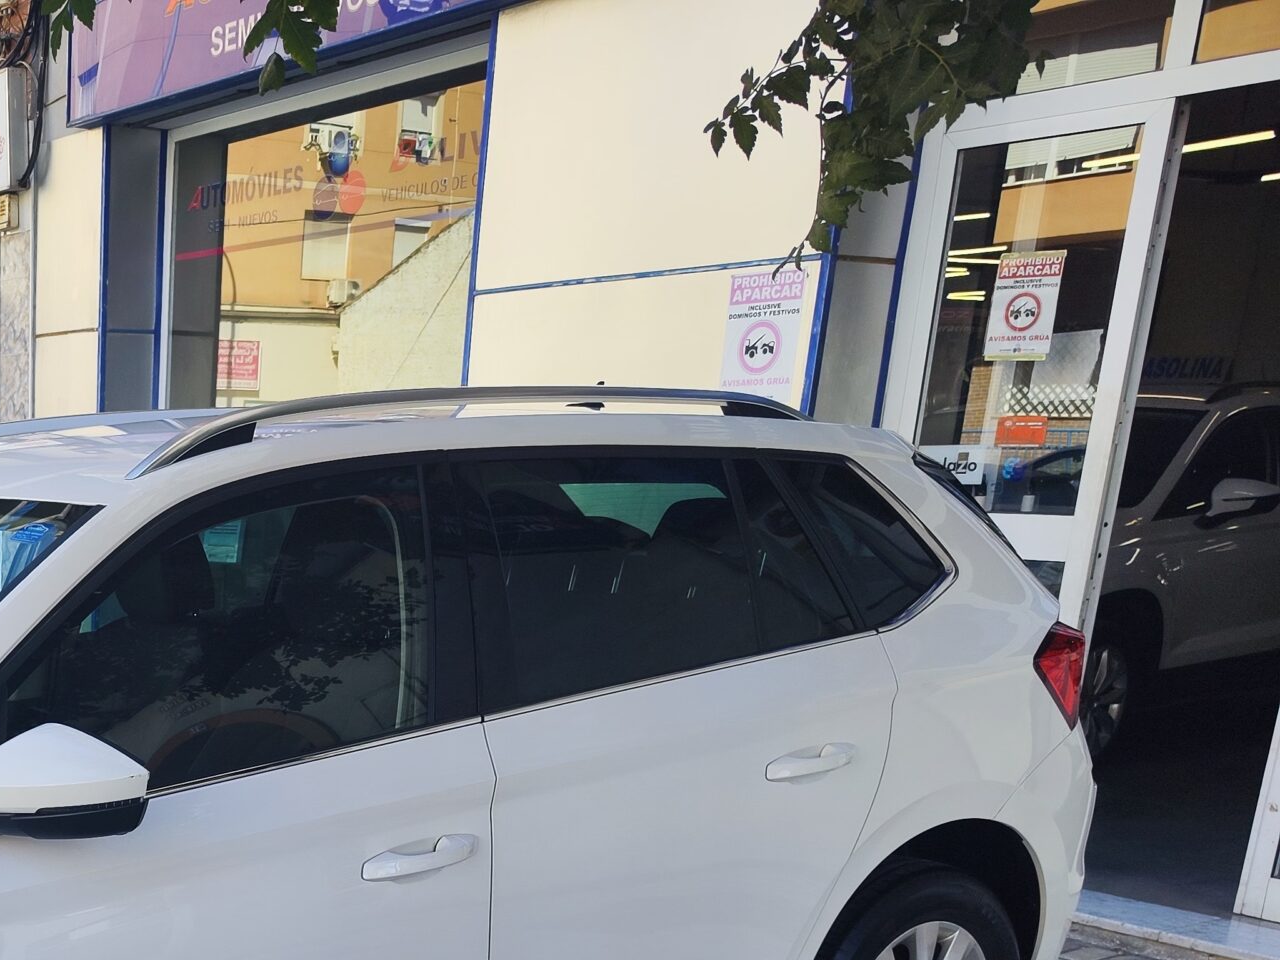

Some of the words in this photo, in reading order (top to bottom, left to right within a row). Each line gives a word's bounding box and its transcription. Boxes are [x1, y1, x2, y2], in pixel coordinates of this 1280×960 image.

[187, 164, 304, 211] AUTOMÓVILES
[451, 174, 469, 190] DE
[238, 209, 279, 229] NUEVOS
[1002, 256, 1062, 267] PROHIBIDO
[1000, 264, 1060, 278] APARCAR
[732, 283, 802, 302] APARCAR
[728, 312, 761, 320] DOMINGOS
[769, 308, 800, 317] FESTIVOS
[747, 303, 782, 311] INCLUSIVE
[722, 379, 764, 388] AVISAMOS
[766, 377, 790, 386] GRUA
